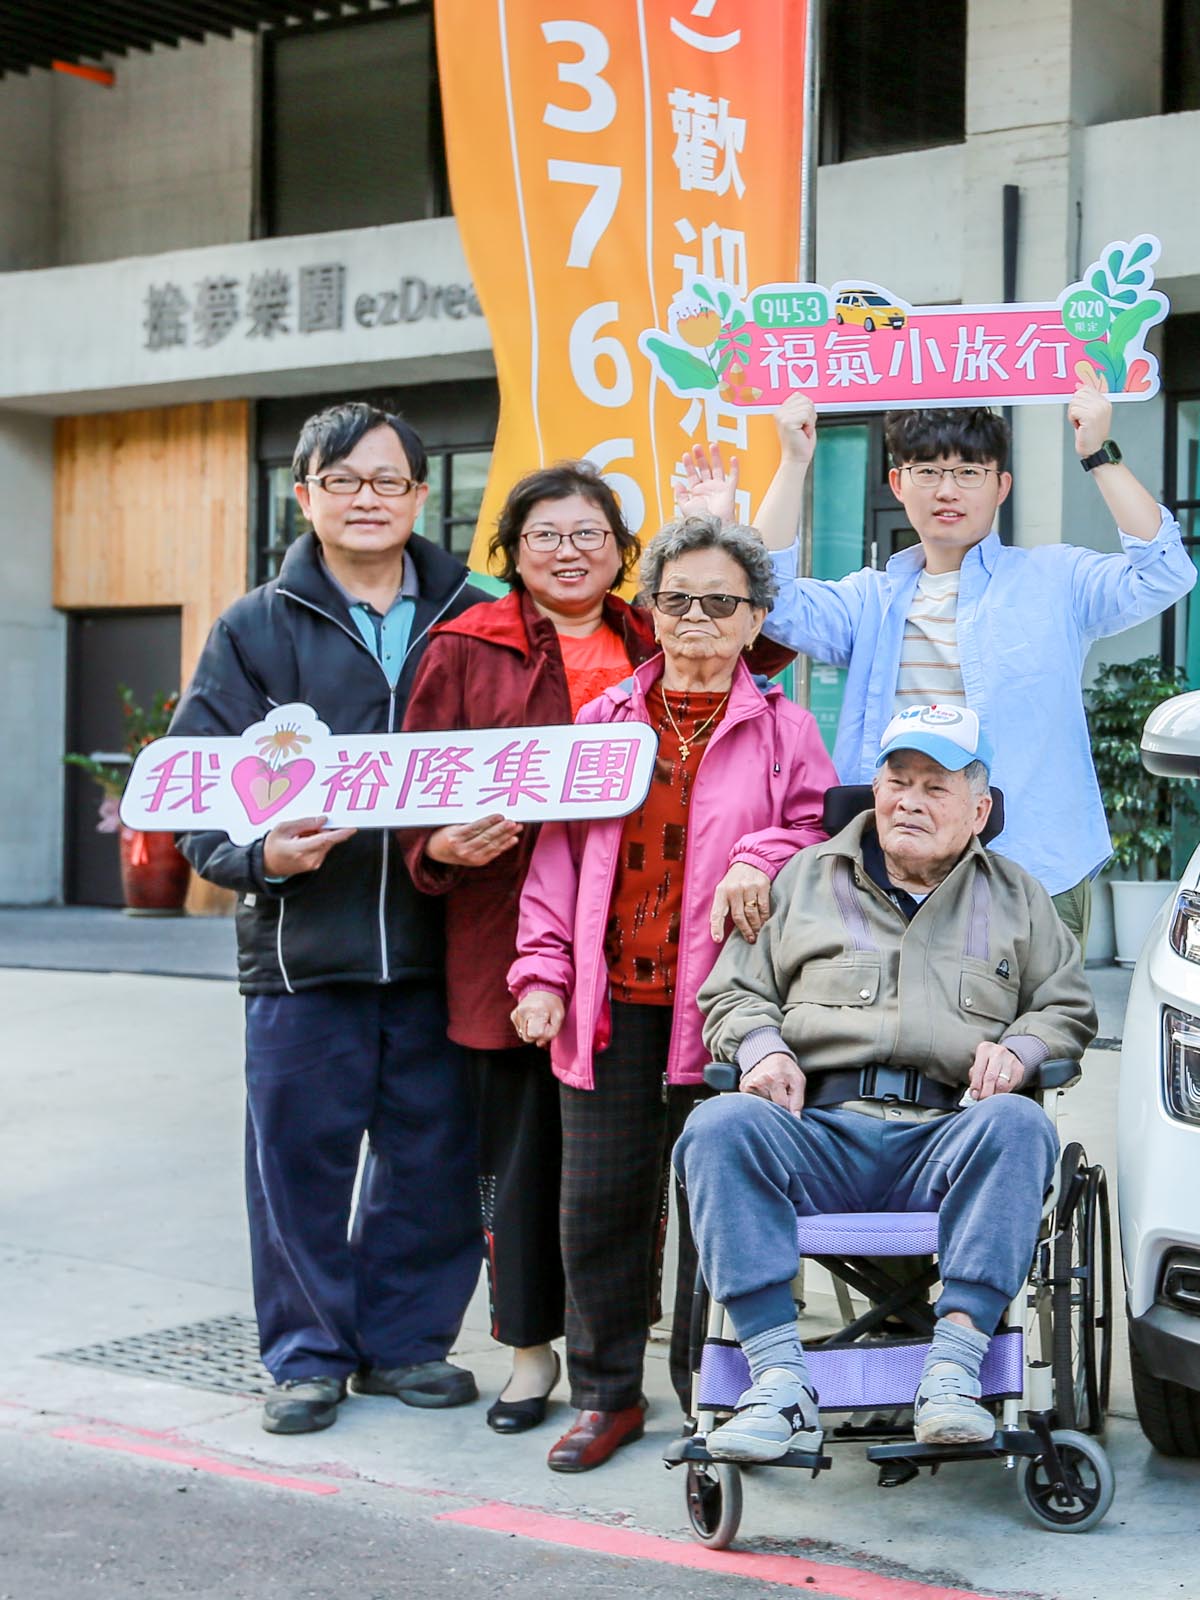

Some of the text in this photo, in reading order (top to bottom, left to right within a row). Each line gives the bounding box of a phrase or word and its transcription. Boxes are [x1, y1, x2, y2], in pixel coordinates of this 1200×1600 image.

[760, 297, 821, 323] 9453
[1069, 300, 1104, 318] 2020
[759, 323, 1070, 389] 福氣小旅行
[141, 739, 641, 814] 我 裕隆集團
